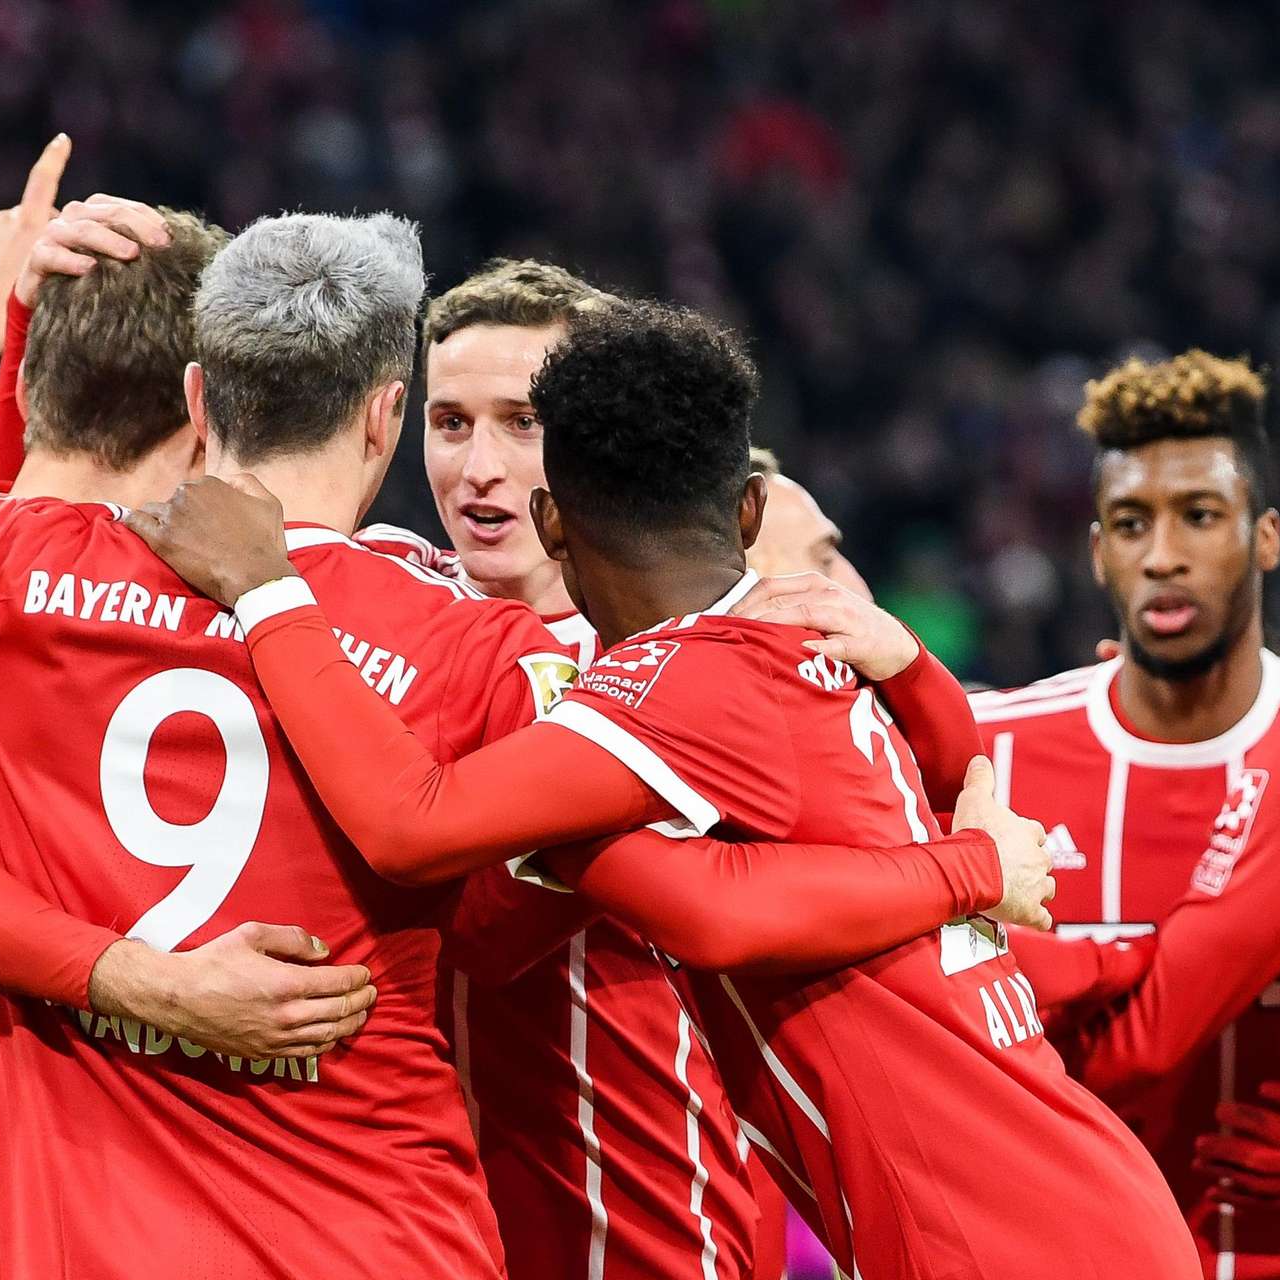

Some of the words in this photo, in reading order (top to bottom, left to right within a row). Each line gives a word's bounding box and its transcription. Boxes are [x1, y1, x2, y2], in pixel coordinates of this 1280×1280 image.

[23, 569, 187, 633] BAYERN
[583, 671, 648, 694] Hamad
[99, 667, 270, 953] 9
